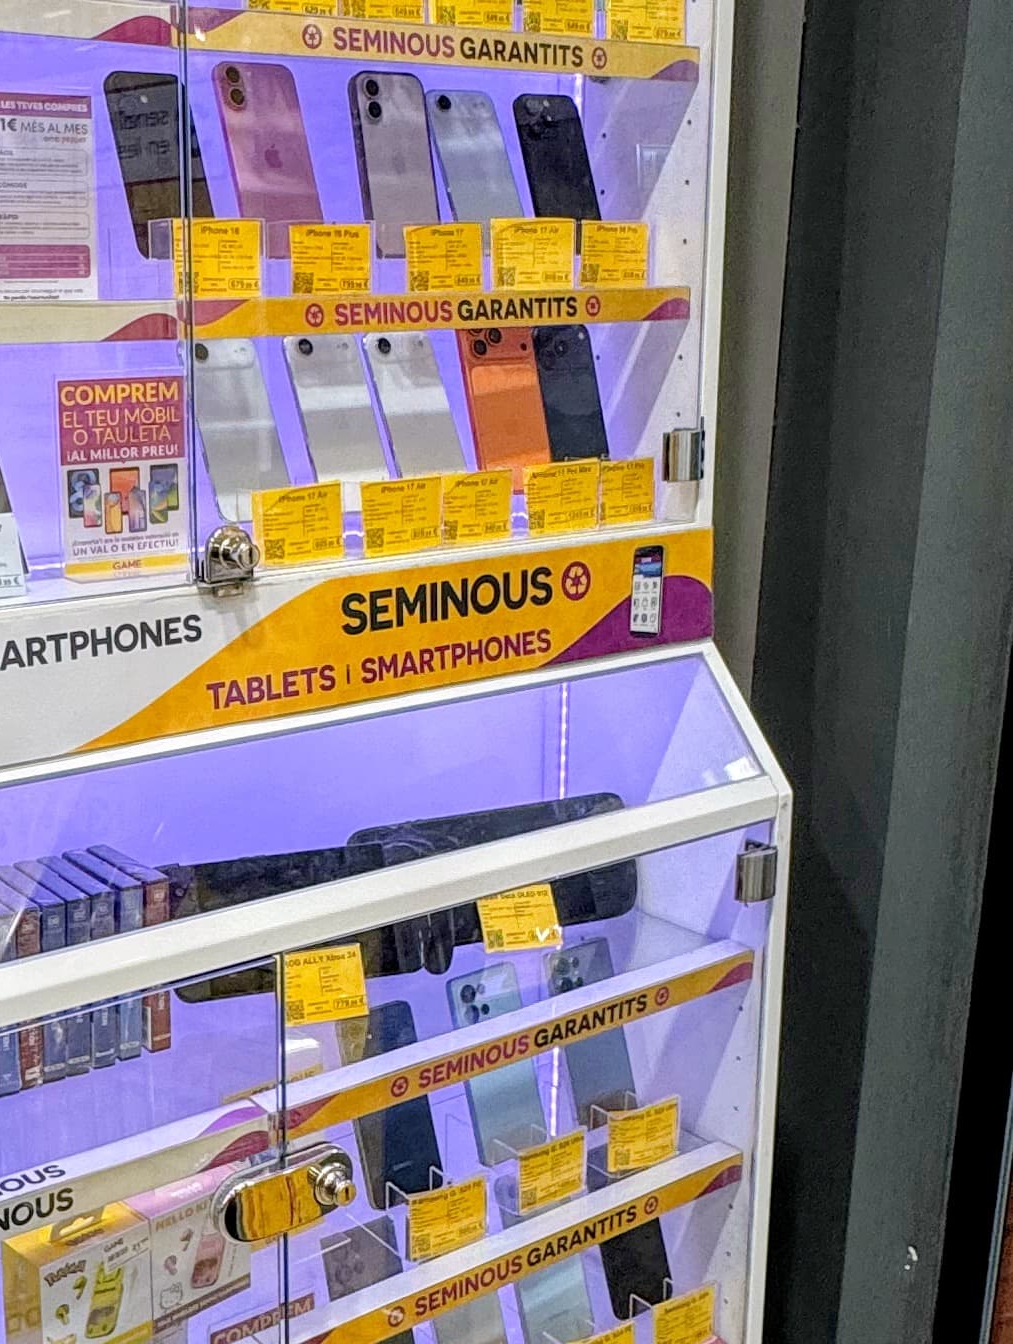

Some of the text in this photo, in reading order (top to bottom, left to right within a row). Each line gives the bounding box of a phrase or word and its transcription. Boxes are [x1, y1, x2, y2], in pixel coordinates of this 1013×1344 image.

[333, 27, 584, 68] SEMINOUS GARANTITS
[48, 123, 61, 134] AL
[64, 123, 88, 135] MES
[335, 296, 578, 326] SEMINOUS GARANTITS
[60, 382, 179, 406] COMPREM
[63, 405, 180, 429] EL TEU MÒBIL
[74, 425, 171, 446] O TAULETA
[90, 444, 179, 461] MILLOR PREU!
[73, 545, 88, 556] UN
[91, 543, 108, 555] VAL
[113, 559, 142, 571] GAME
[341, 566, 553, 636] SEMINOUS
[206, 628, 551, 711] TABLETS SMARTPHONES
[303, 956, 324, 967] ALLY
[418, 994, 647, 1089] SEMINOUS GARANTITS
[415, 1208, 636, 1316] SEMINOUS GARANTITS
